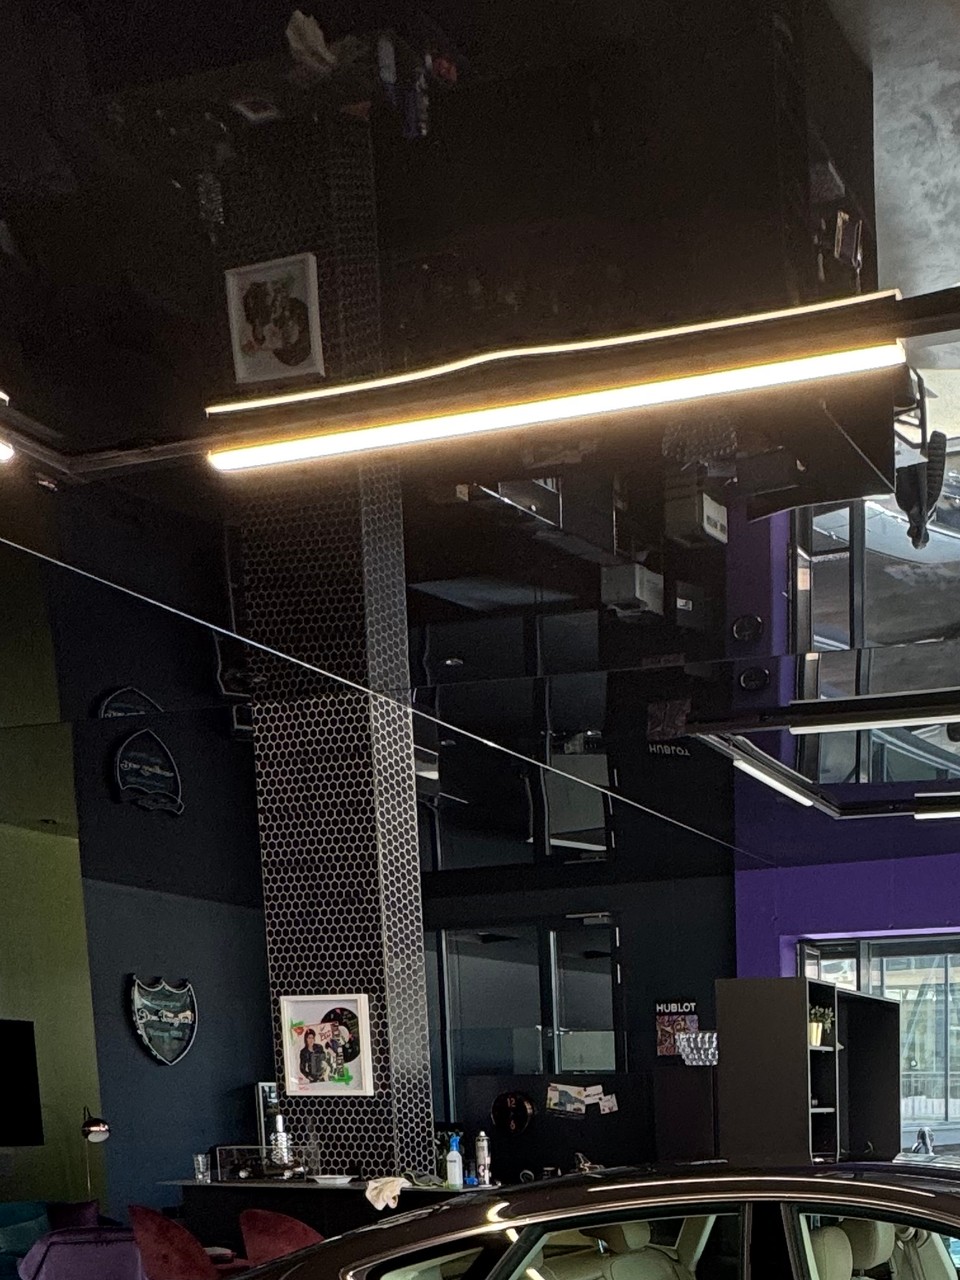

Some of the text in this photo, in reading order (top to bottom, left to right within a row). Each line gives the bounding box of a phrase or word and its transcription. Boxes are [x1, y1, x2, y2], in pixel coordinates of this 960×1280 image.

[656, 1003, 696, 1012] HUBLOT
[507, 1097, 516, 1108] 12
[509, 1119, 516, 1130] 6
